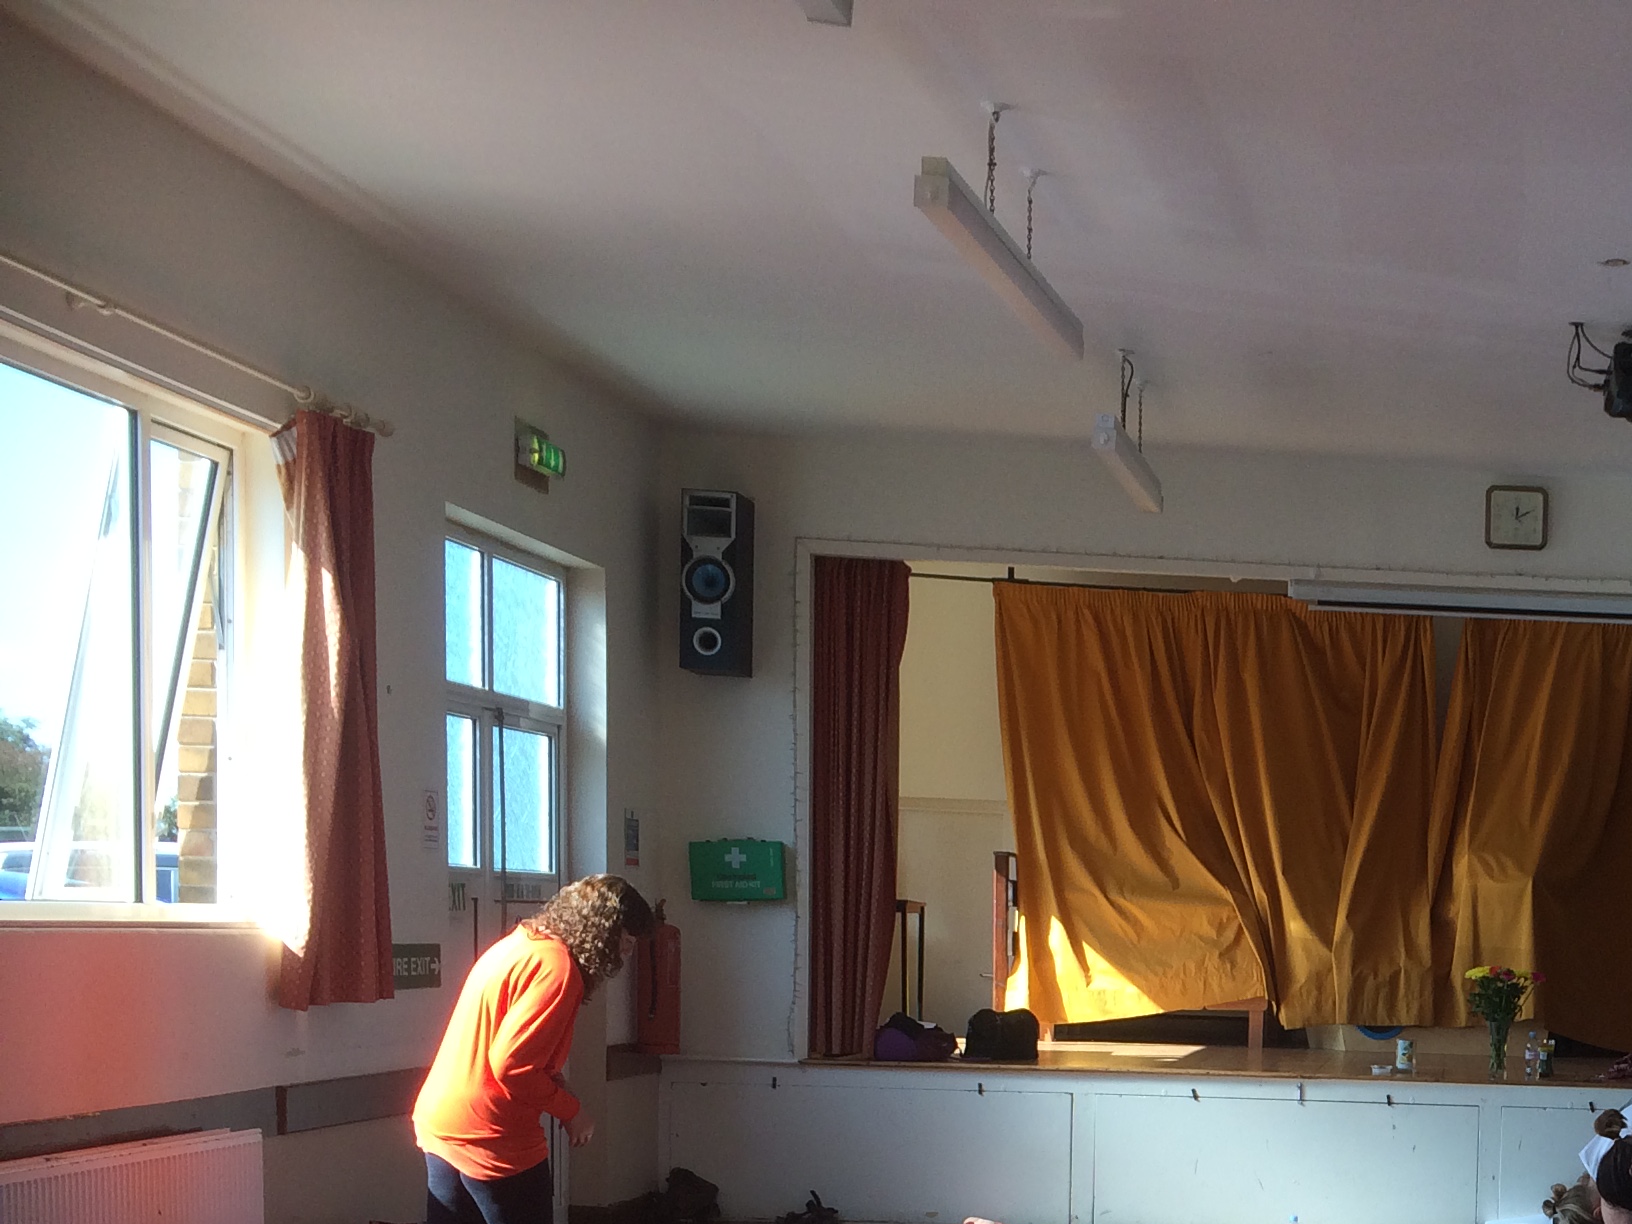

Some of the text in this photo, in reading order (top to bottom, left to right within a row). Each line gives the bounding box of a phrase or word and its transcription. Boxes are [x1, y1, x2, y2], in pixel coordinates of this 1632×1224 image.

[712, 880, 733, 889] FIRST
[735, 880, 748, 889] AID
[392, 956, 431, 976] IRE EXIT
